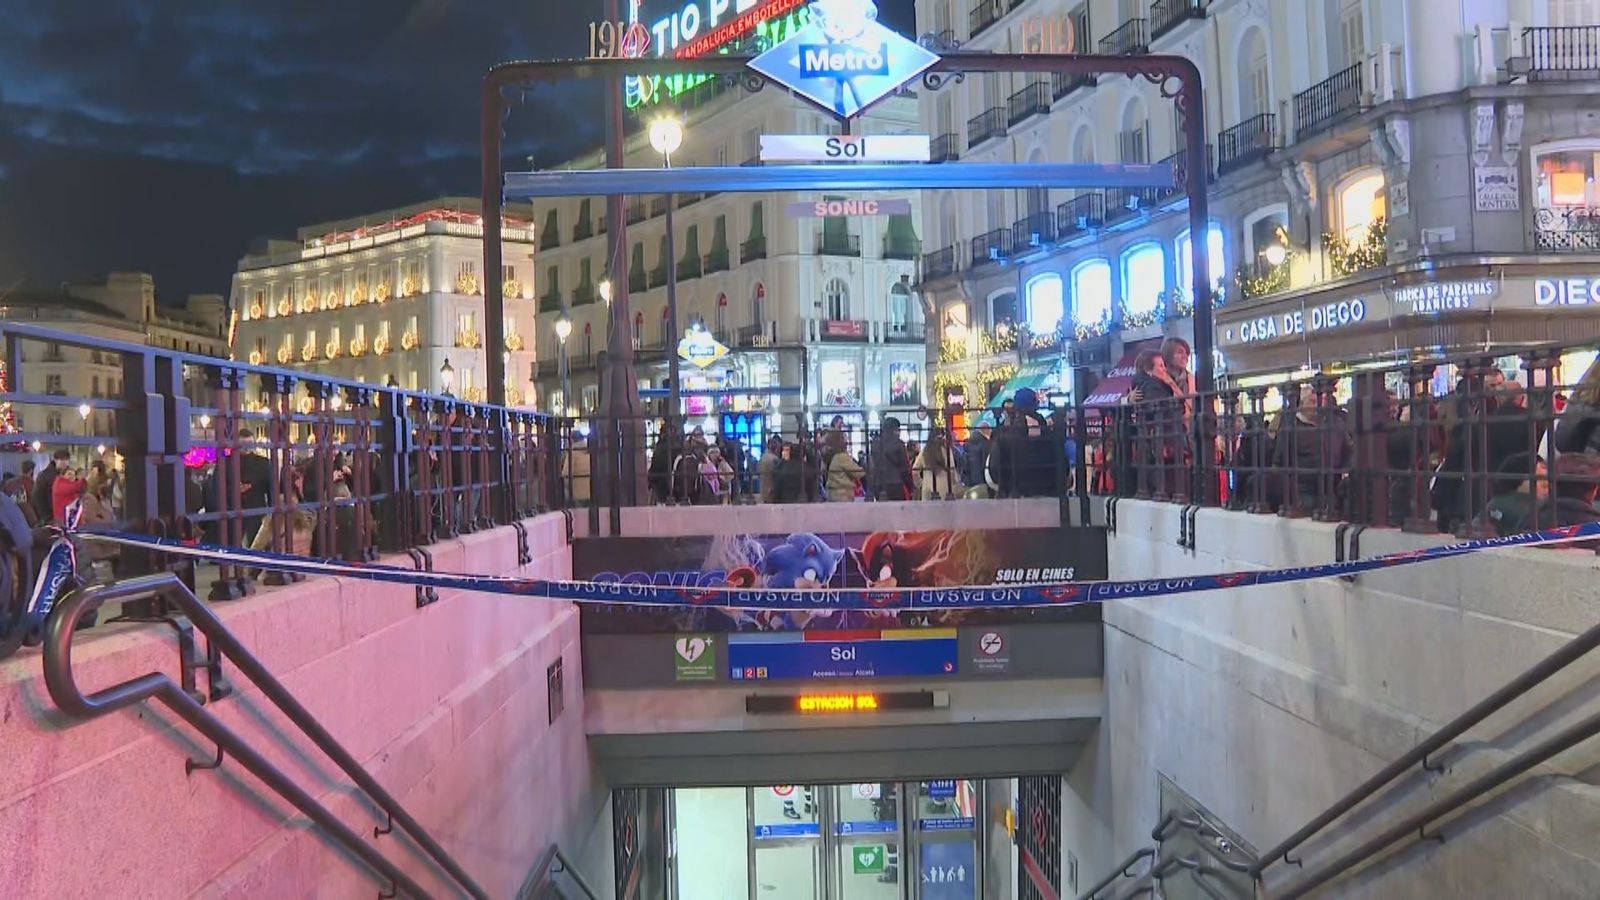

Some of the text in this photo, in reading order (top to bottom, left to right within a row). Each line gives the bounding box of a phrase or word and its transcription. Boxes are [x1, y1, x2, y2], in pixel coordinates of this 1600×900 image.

[652, 3, 700, 57] TIO
[804, 49, 884, 73] Metro
[826, 138, 866, 157] Sol
[815, 201, 879, 216] SONIC
[1427, 286, 1440, 298] DE
[1412, 296, 1470, 312] ABANICOS
[1240, 299, 1366, 343] CASA DE DIEGO
[996, 567, 1074, 582] SOLO EN CINES
[920, 587, 1021, 602] NO PASAR
[1098, 578, 1195, 596] NO PASAR
[810, 590, 840, 603] NO
[831, 646, 856, 661] Sol
[856, 694, 878, 710] SOL
